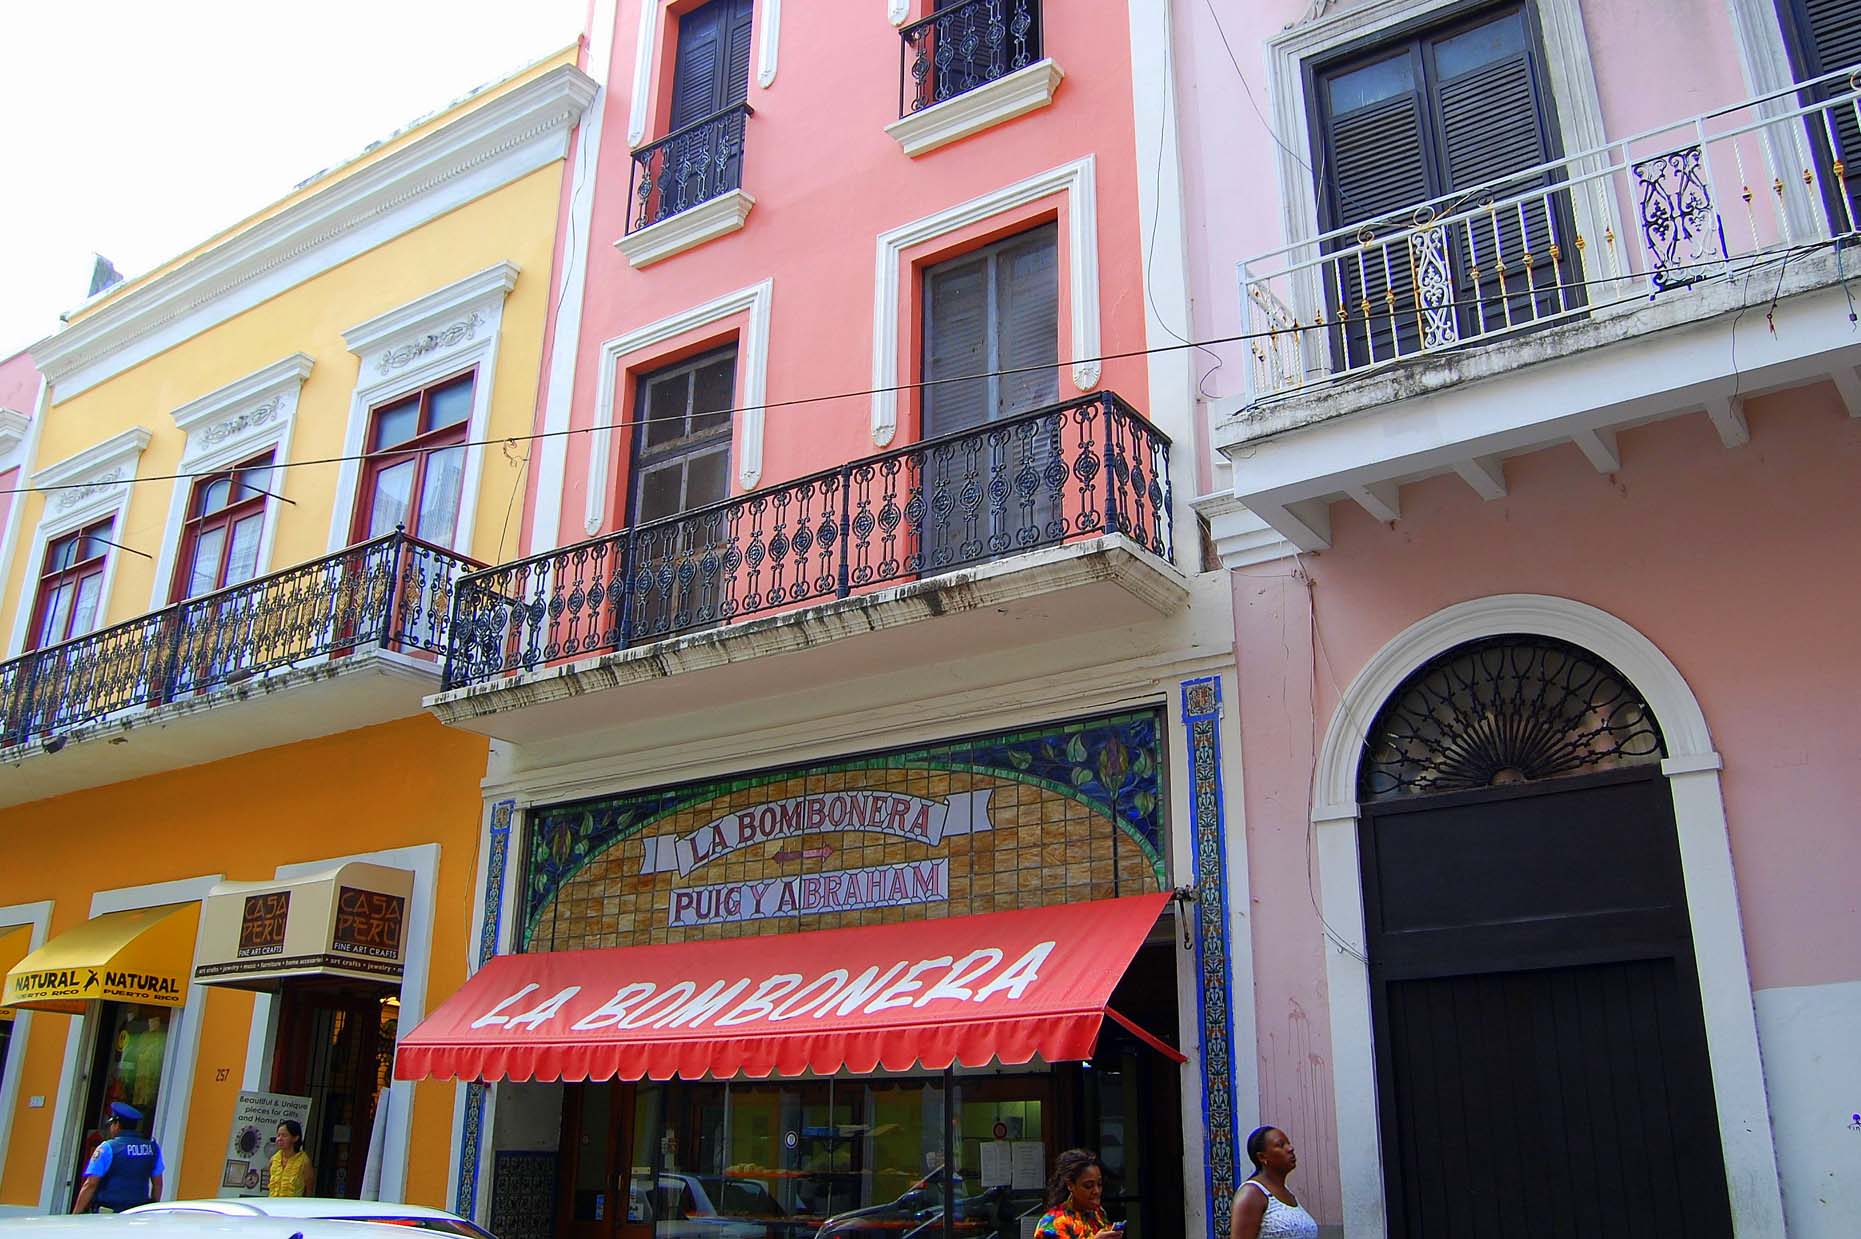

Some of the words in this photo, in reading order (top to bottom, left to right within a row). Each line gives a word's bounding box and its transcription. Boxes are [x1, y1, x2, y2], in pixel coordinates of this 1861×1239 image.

[689, 821, 729, 864] LA
[737, 795, 930, 844] BOMBONERA
[750, 883, 771, 914] Y
[777, 863, 941, 912] ABRAHAM
[244, 895, 288, 919] CASA
[341, 892, 400, 920] CASA
[239, 948, 250, 957] FINE
[250, 947, 261, 956] ART
[262, 945, 282, 954] CRAFTS
[334, 942, 351, 952] FINE
[353, 945, 367, 954] ART
[369, 947, 397, 959] CRAFTS
[342, 960, 361, 968] crafts
[16, 970, 81, 991] NATURAL
[105, 971, 180, 993] NATURAL
[470, 982, 583, 1031] LA
[571, 940, 1057, 1031] BOMBONERA
[52, 988, 80, 997] RICO
[103, 988, 149, 999] PUERTO
[154, 994, 180, 1002] RICO
[239, 1096, 272, 1106] Beautiful
[281, 1100, 308, 1110] Unique
[245, 1105, 269, 1115] pieces
[271, 1108, 282, 1116] for
[255, 1115, 278, 1124] Home
